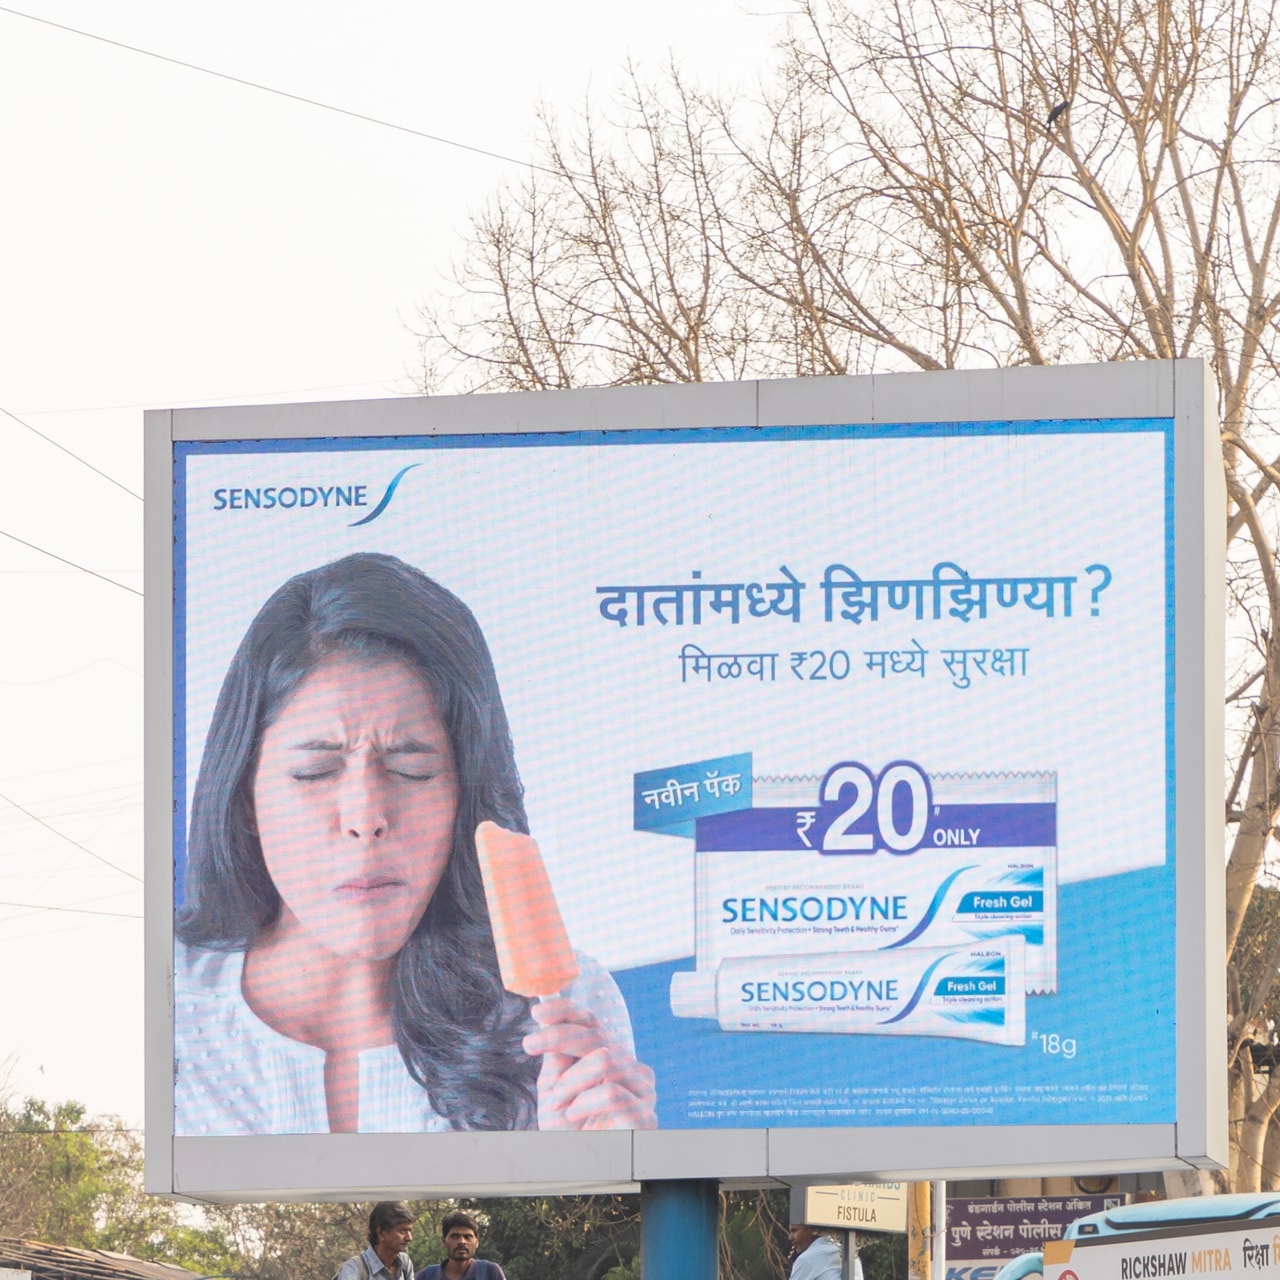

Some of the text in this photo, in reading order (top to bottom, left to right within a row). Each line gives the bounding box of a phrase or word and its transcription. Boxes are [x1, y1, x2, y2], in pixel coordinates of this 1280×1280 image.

[214, 485, 367, 510] SENSODYNE
[596, 565, 806, 627] दातांमध्ये
[679, 638, 1030, 689] मिळवा ₹20 मध्ये सुरक्षा
[642, 770, 743, 810] नवीन पॅक
[933, 829, 980, 846] ONLY
[722, 896, 907, 923] SENSODYNE
[973, 896, 1032, 908] Fresh Gel
[741, 979, 898, 1002] SENSODYNE
[947, 981, 996, 992] Fresh Gel
[840, 1189, 875, 1203] CLINIC
[1007, 1199, 1035, 1213] पोलीस
[1038, 1198, 1063, 1212] स्टेशन
[837, 1205, 877, 1223] FISTULA
[951, 1218, 1062, 1247] पुणे स्टेशन पोलीस
[1121, 1247, 1232, 1280] RICKSHAW MITRA
[1243, 1237, 1270, 1270] रिक्षा
